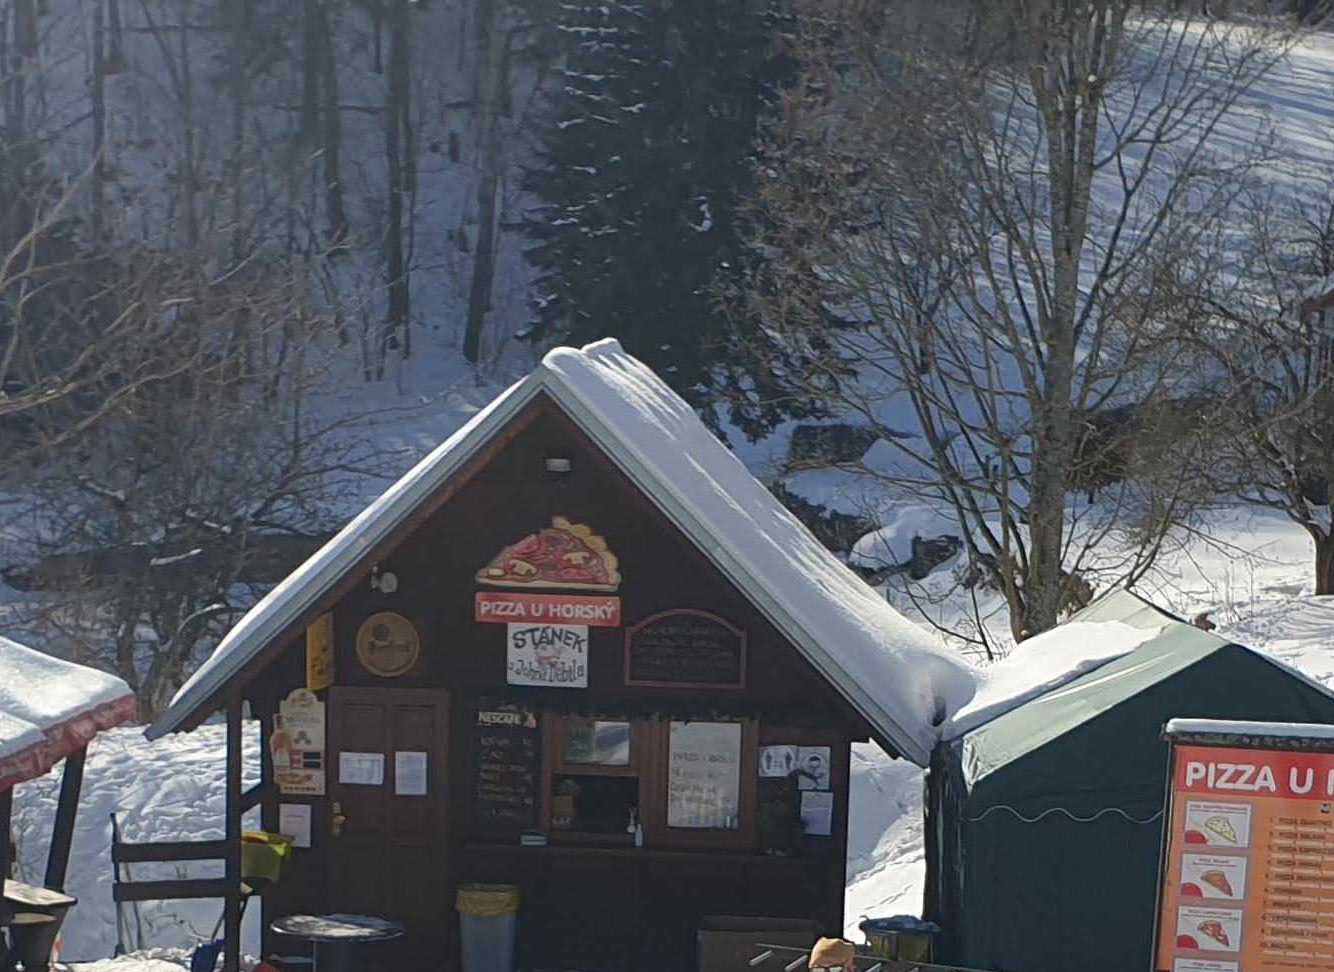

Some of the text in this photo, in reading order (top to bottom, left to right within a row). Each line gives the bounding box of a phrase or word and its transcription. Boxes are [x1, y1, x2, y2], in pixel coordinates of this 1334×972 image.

[480, 601, 615, 618] PIZZA U HORSKÝ
[1186, 762, 1276, 793] PIZZA
[1289, 767, 1313, 794] U
